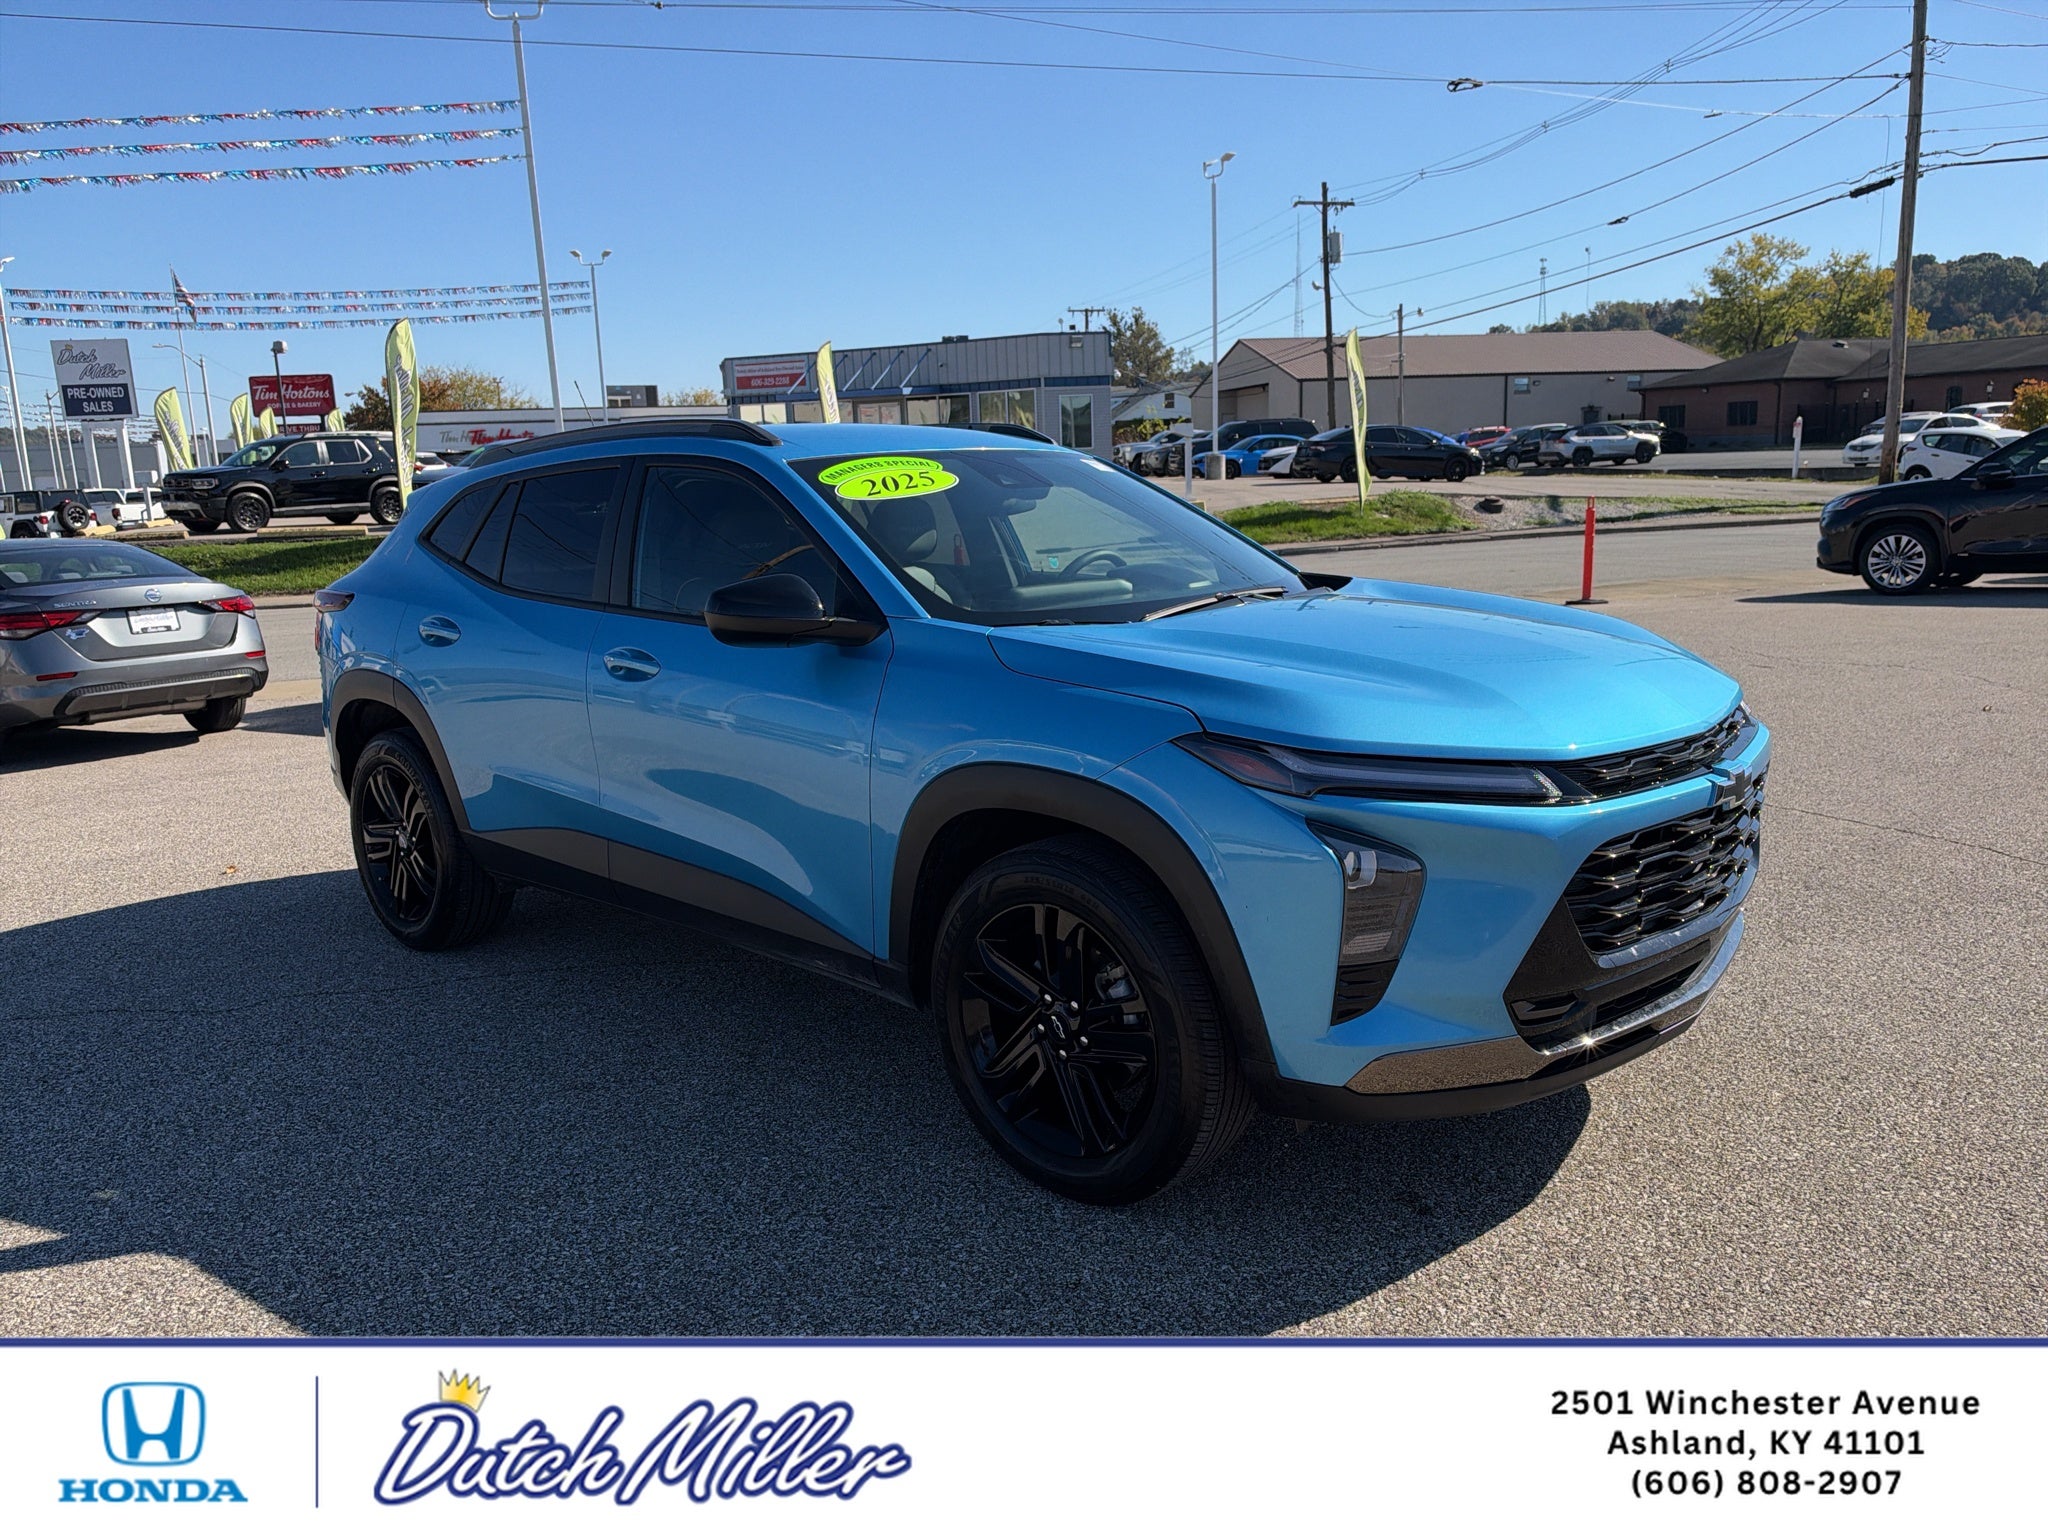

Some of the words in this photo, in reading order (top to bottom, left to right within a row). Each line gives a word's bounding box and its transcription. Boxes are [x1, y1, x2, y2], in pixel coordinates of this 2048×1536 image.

[57, 348, 98, 366] Dutch
[79, 363, 127, 380] Miller
[66, 386, 125, 400] PRE-OWNED
[252, 385, 278, 400] Tim
[281, 383, 330, 400] Hortons
[82, 401, 114, 413] SALES
[299, 424, 320, 433] THRU
[825, 460, 883, 481] MANAGERS
[884, 459, 933, 468] SPECIAL
[861, 471, 936, 497] 2025
